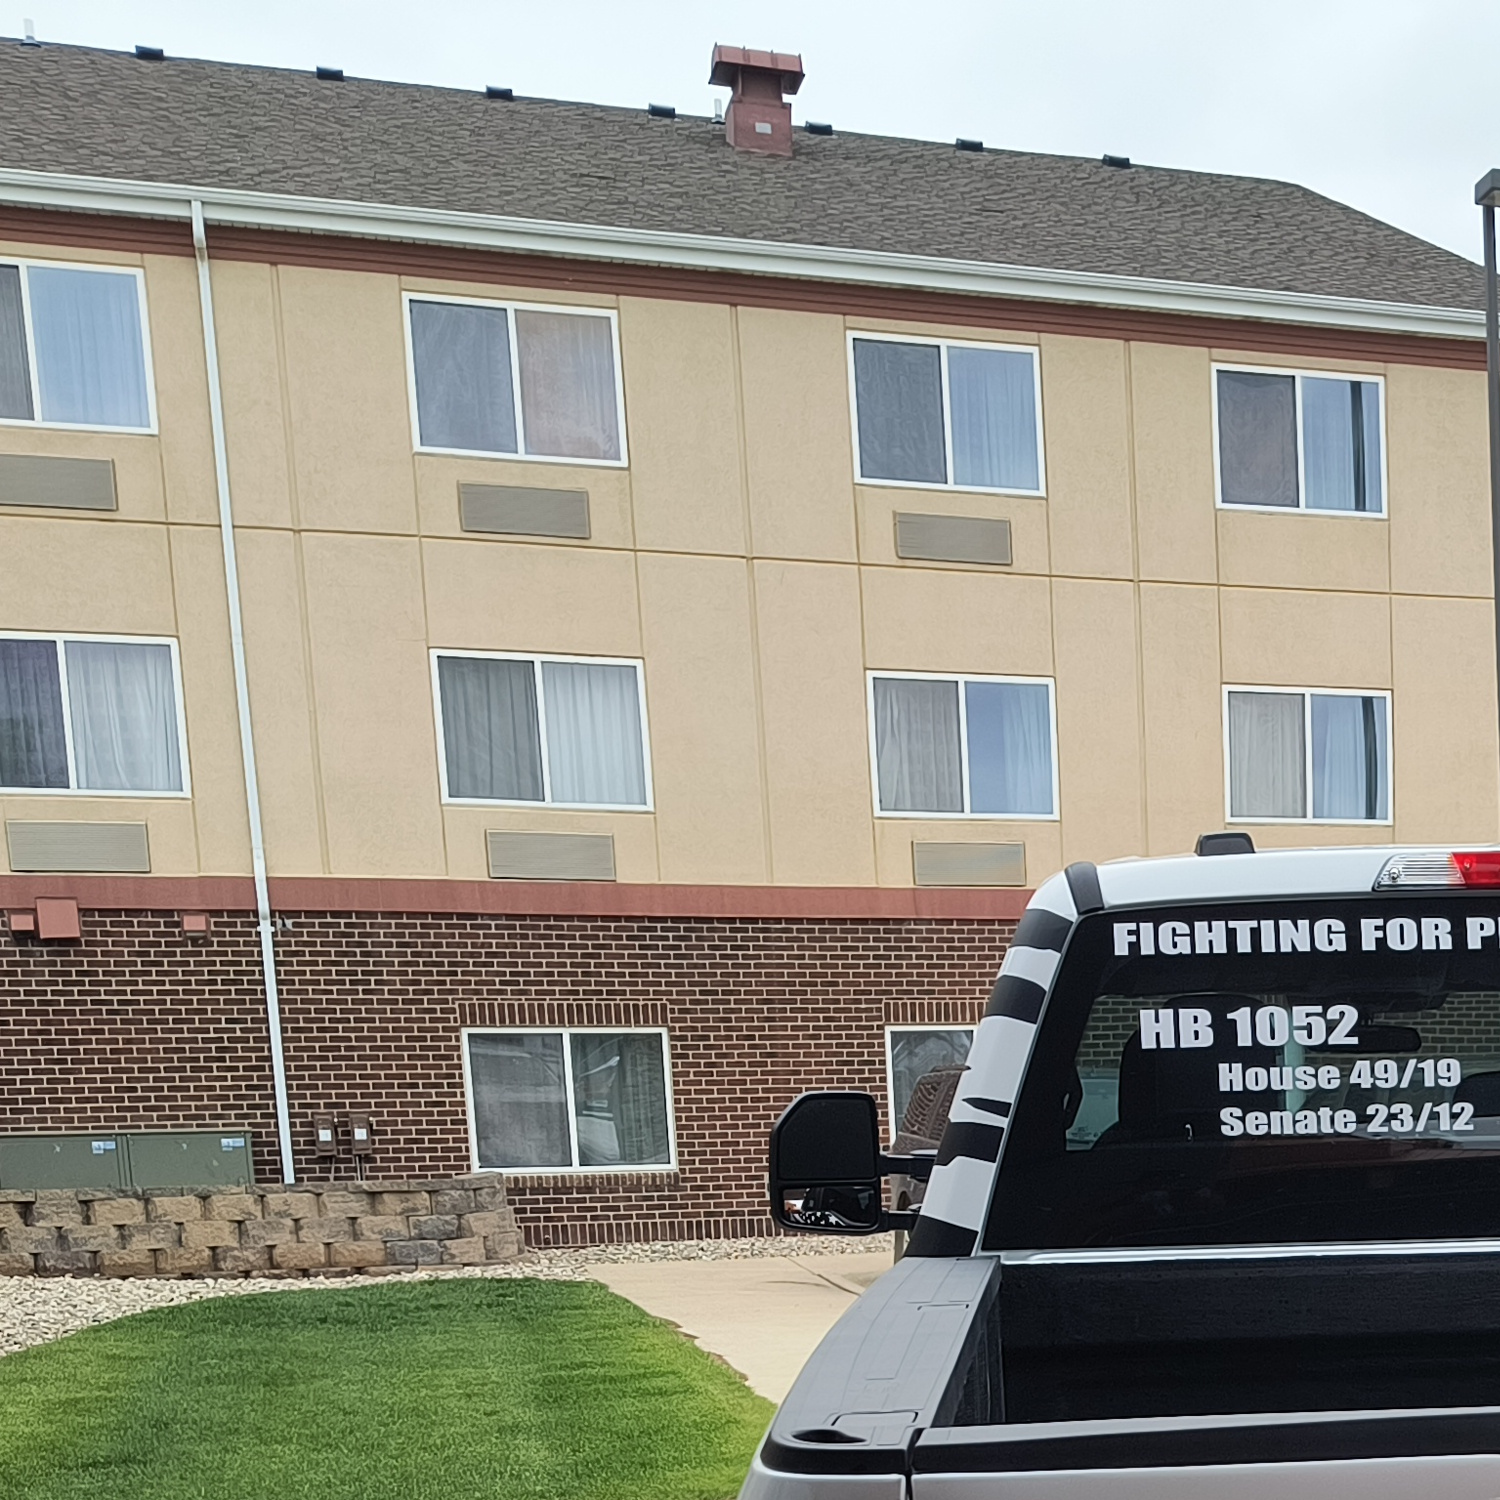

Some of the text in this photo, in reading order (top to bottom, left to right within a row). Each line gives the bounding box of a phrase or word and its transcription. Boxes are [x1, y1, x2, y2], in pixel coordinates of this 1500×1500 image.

[1113, 917, 1347, 956] FIGHTING
[1361, 916, 1452, 952] FOR
[1139, 1004, 1360, 1049] HB 1052
[1218, 1058, 1462, 1092] House 49/19
[1220, 1102, 1475, 1137] Senate 23/12
